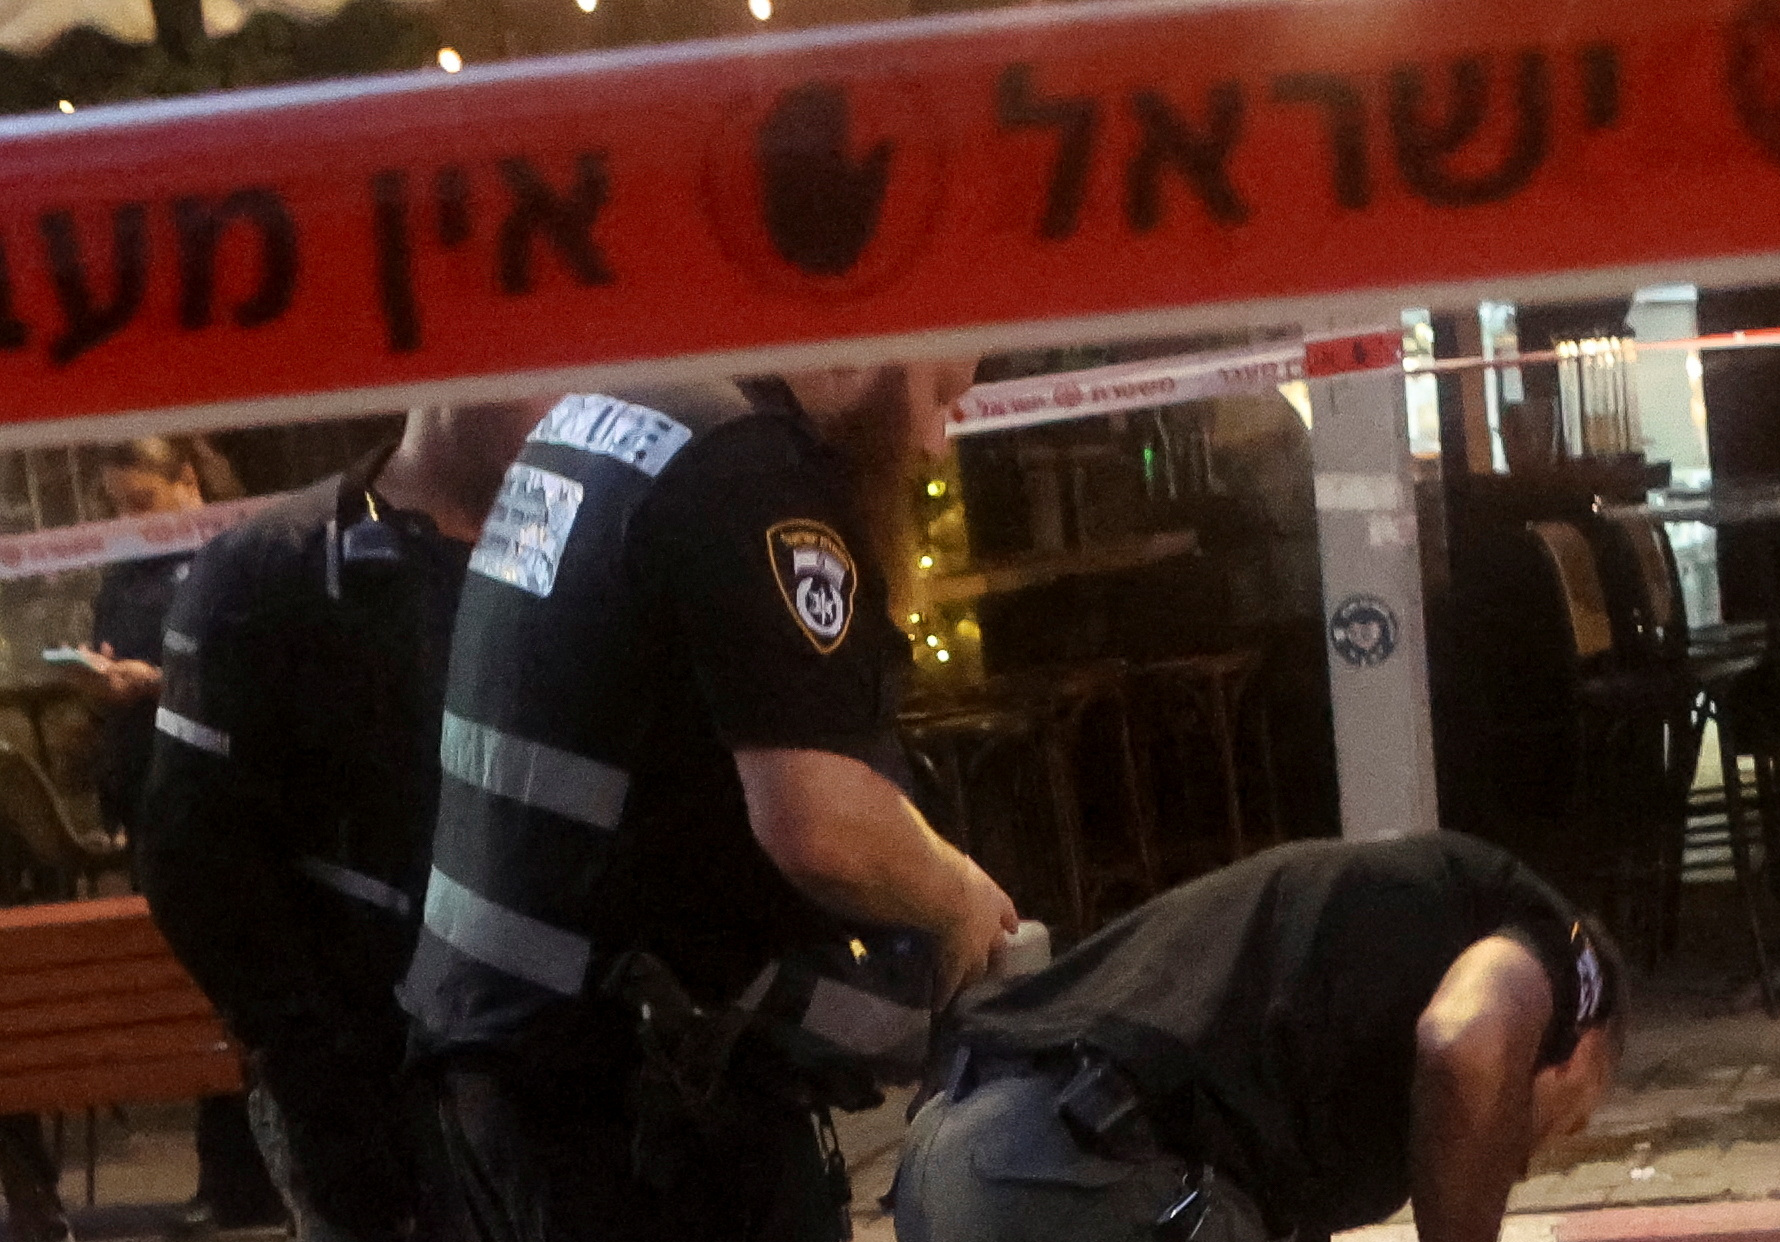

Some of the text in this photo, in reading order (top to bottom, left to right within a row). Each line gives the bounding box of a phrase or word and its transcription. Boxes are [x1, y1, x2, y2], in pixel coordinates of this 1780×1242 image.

[997, 44, 1623, 240] ישראל
[0, 186, 298, 366] מע
[370, 152, 616, 353] אין
